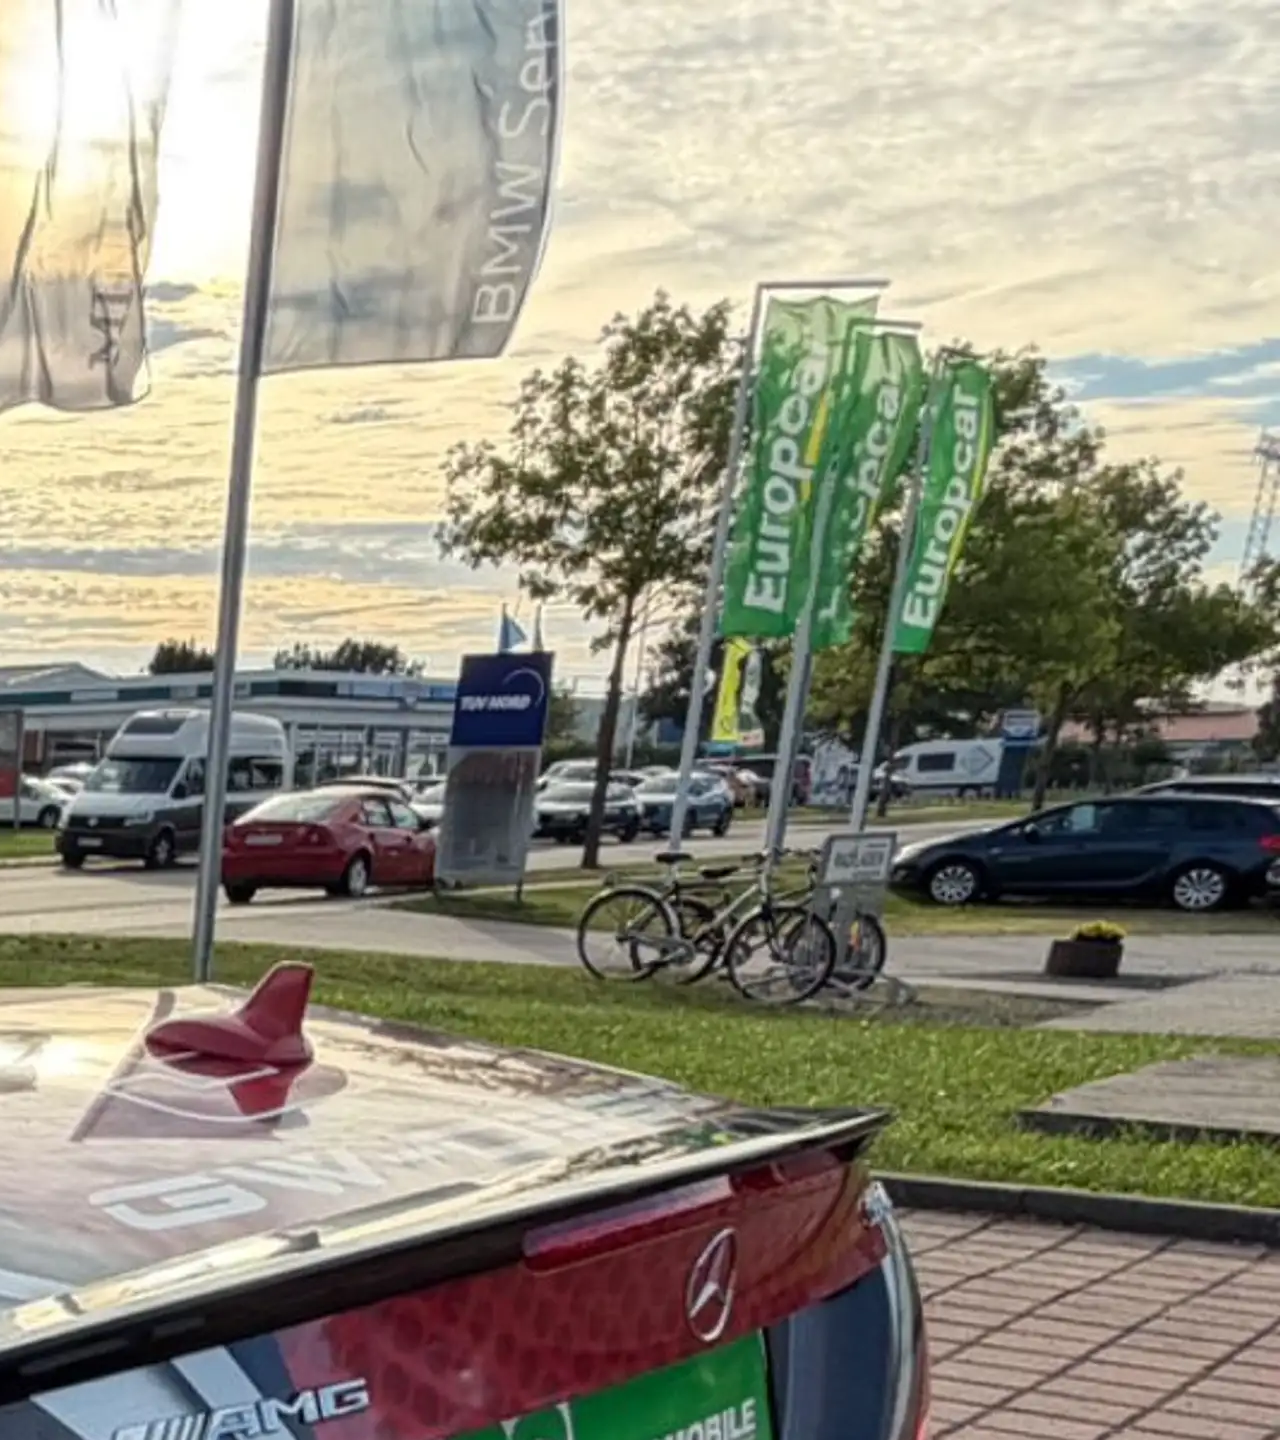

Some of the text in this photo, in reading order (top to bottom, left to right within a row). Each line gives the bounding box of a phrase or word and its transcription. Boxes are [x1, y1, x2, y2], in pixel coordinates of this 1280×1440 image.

[471, 161, 540, 323] BMW
[743, 341, 829, 613] Europcar
[902, 383, 980, 630] Europcar
